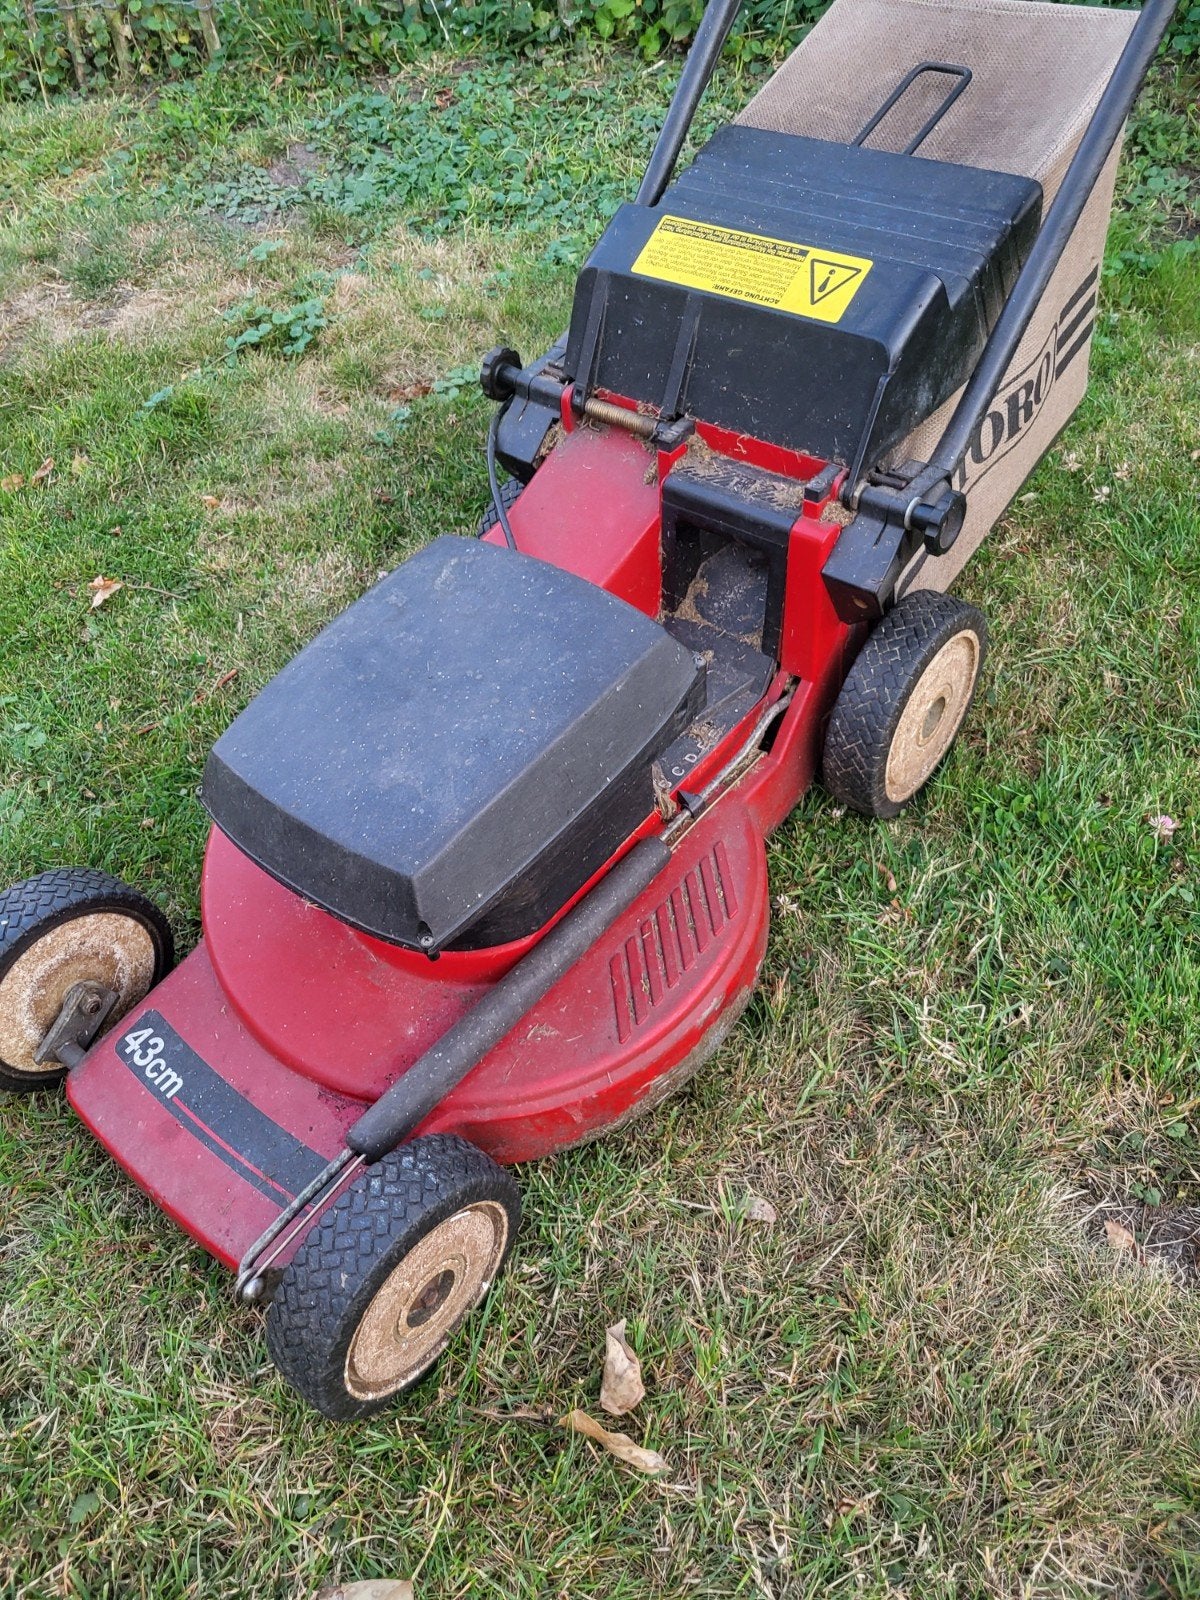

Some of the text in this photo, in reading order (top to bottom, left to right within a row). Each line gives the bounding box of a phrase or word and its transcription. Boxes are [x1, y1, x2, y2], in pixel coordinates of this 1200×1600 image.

[711, 283, 780, 304] ACHTUNG GEFAHR!
[671, 753, 698, 776] C D
[124, 1027, 184, 1099] 43cm
